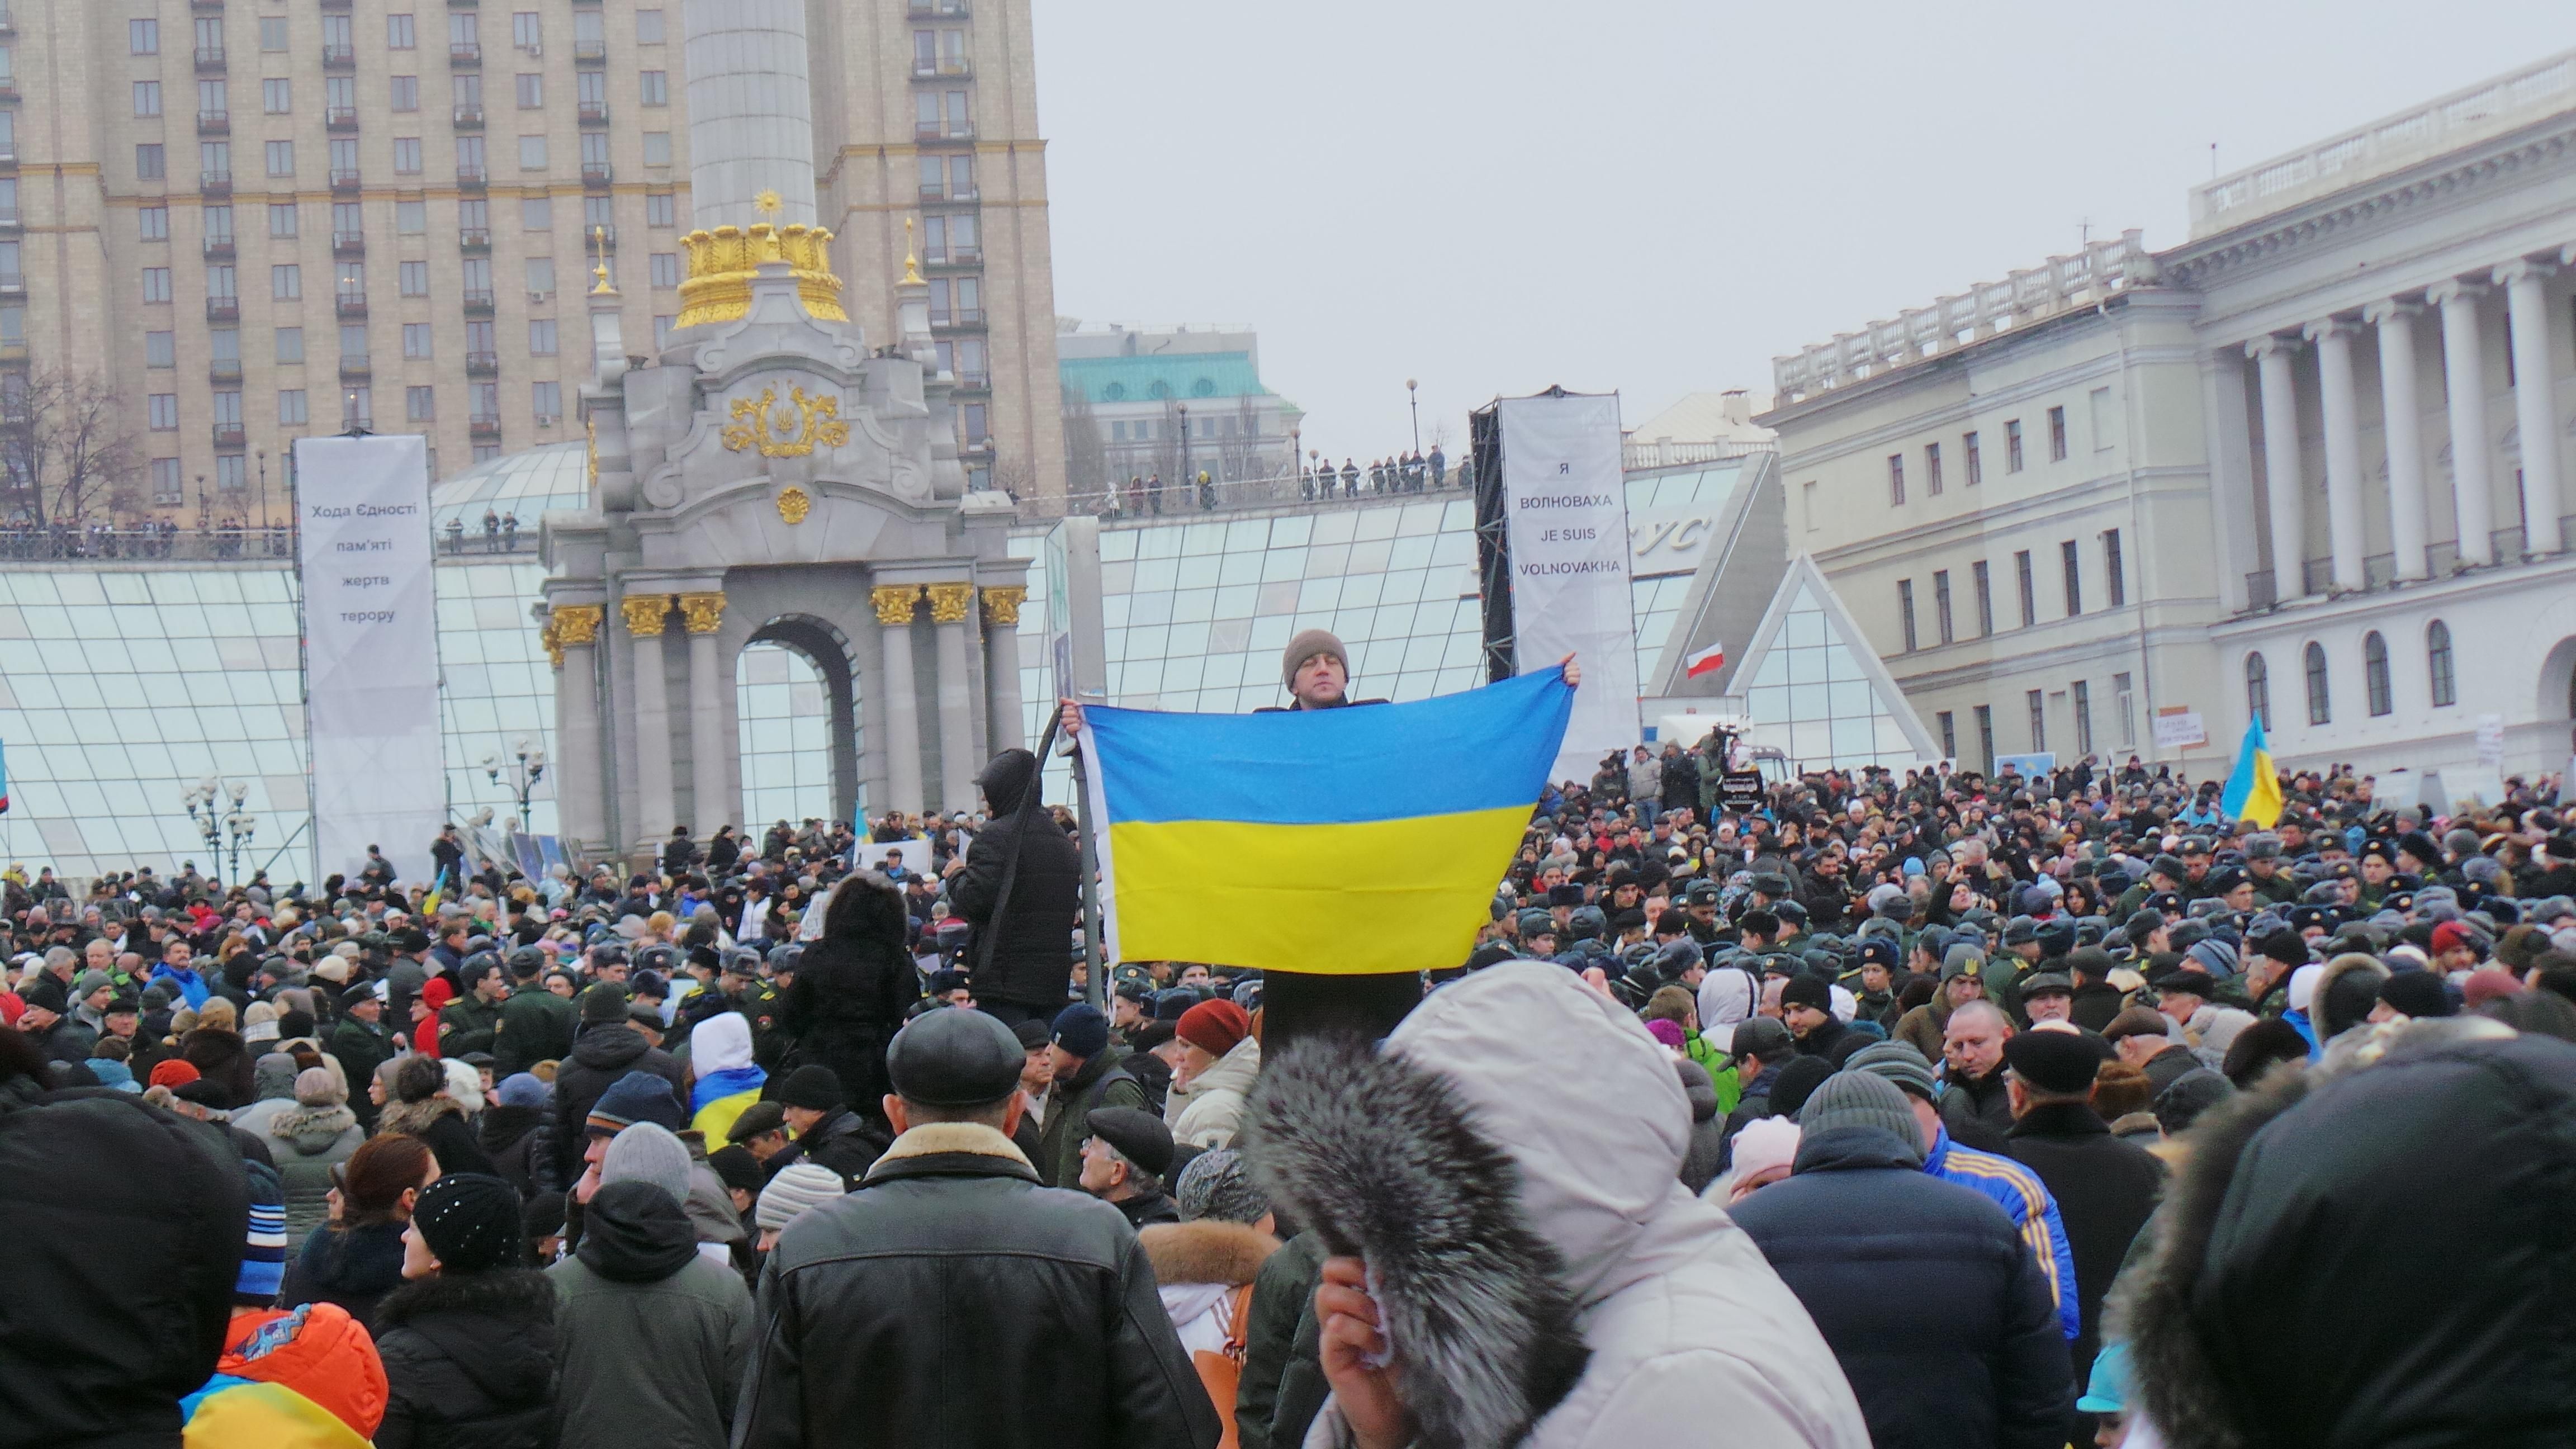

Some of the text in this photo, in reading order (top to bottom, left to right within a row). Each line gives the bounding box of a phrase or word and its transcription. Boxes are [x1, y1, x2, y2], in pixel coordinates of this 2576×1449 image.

[1560, 463, 1569, 474] Я
[1520, 494, 1613, 509] ВОЛНОВАХА
[312, 503, 417, 518] Хода Єдності
[1541, 528, 1596, 542] JE SUIS
[1520, 561, 1621, 576] VOLNOVAKHA
[342, 576, 390, 589] жертв
[340, 611, 394, 624] терору
